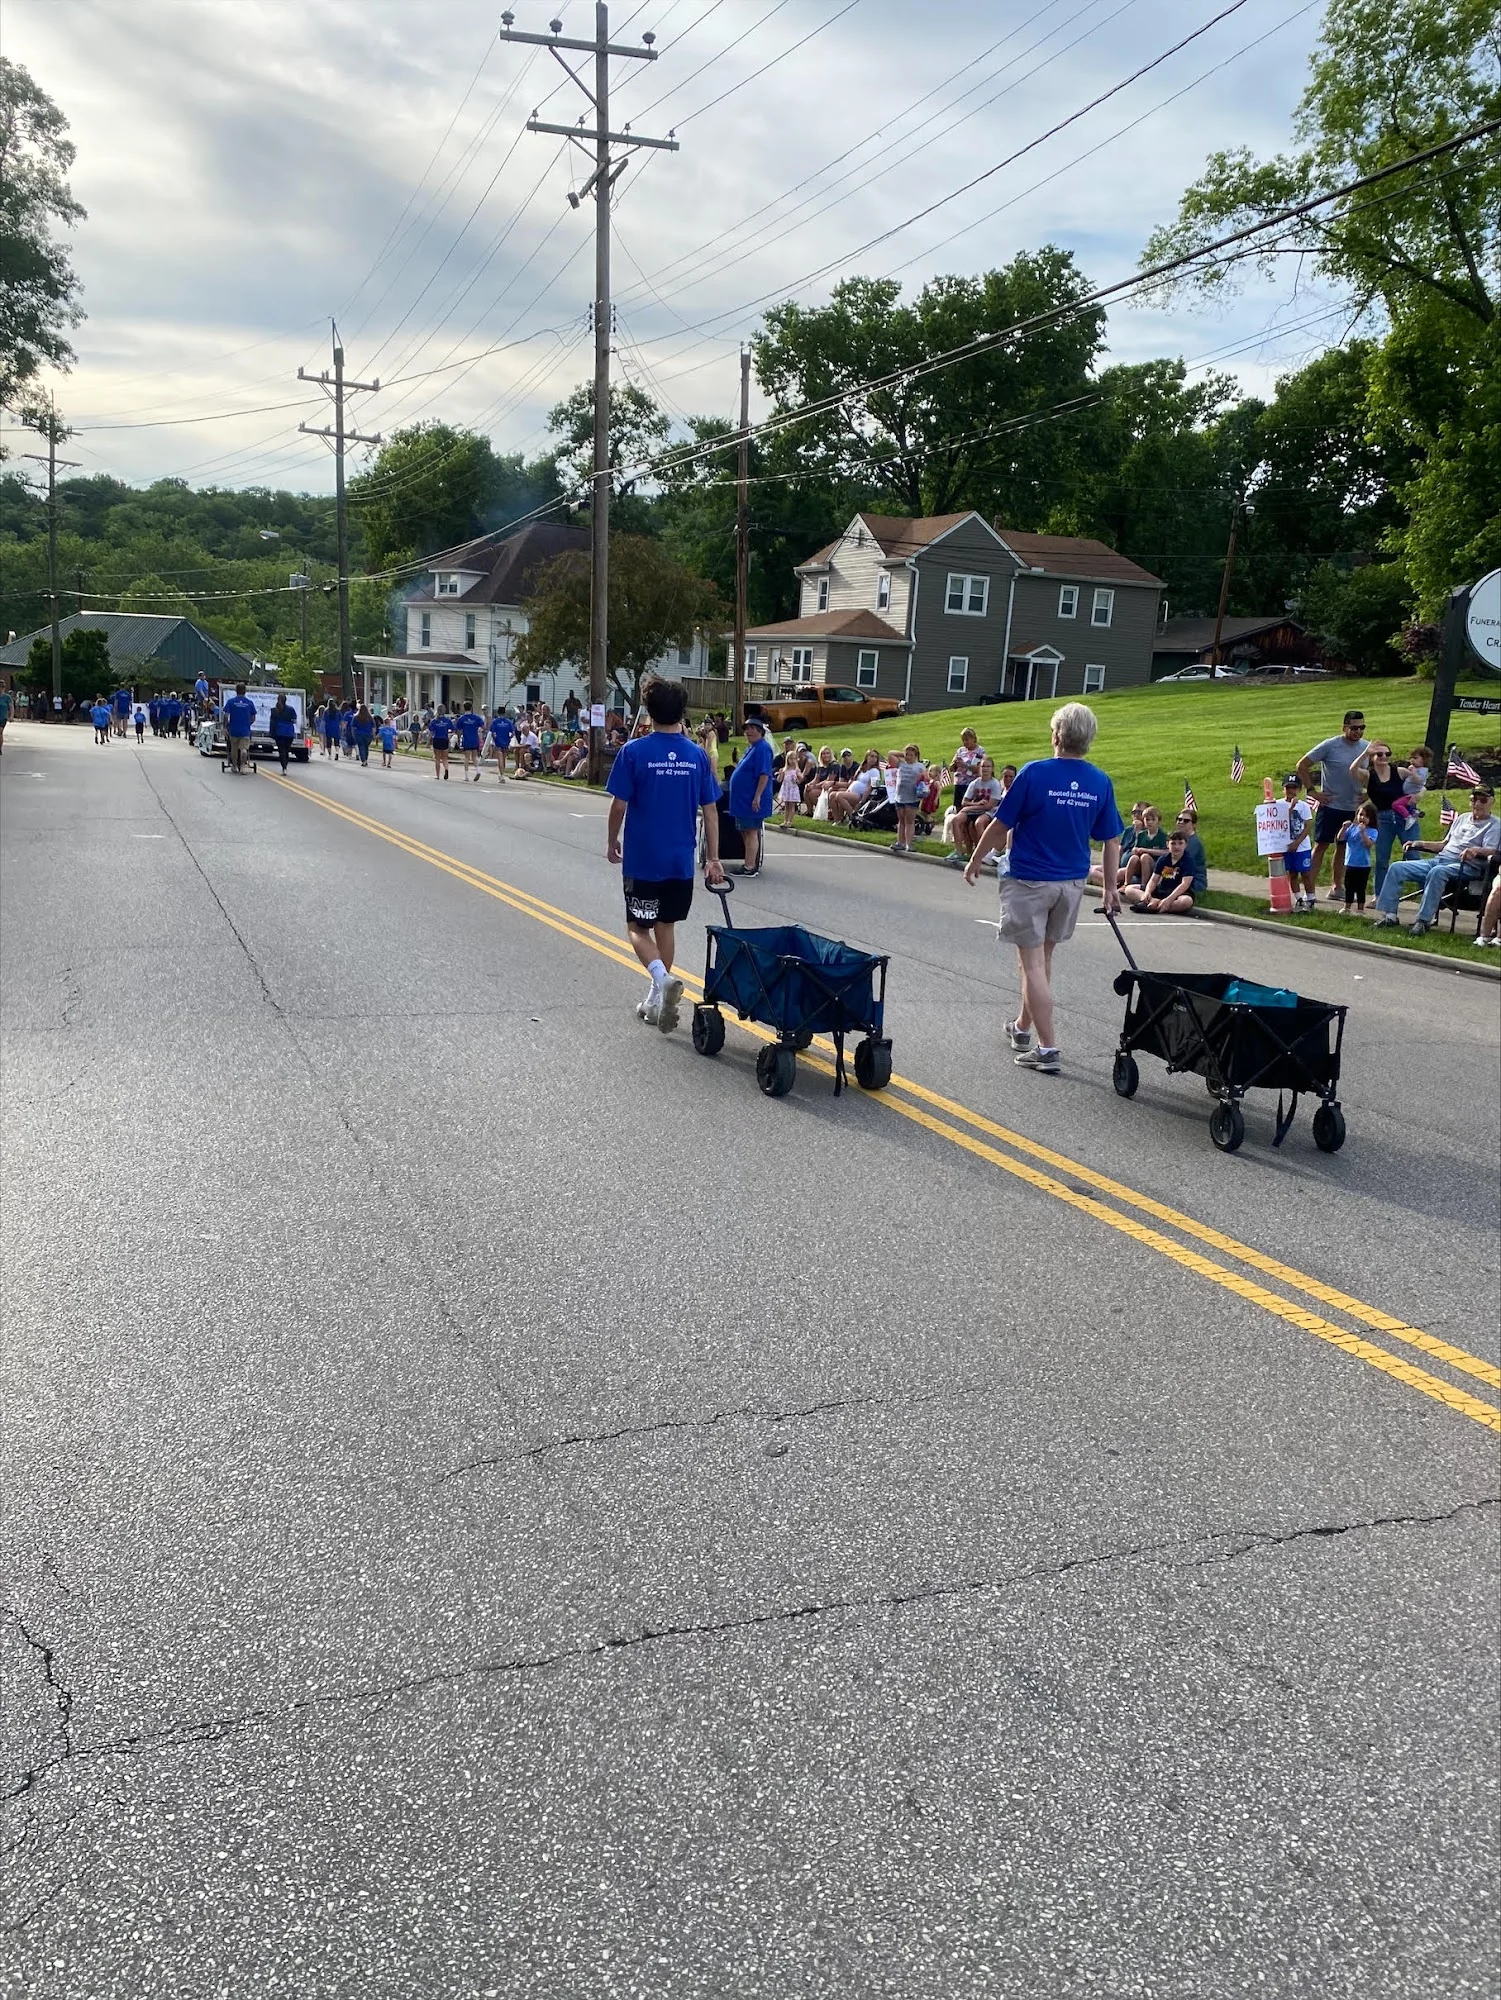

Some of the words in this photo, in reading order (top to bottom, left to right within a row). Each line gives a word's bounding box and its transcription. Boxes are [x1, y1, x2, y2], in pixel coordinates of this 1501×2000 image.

[1486, 637, 1501, 647] CR
[1460, 698, 1482, 709] Tender
[1266, 807, 1278, 817] NO
[1258, 820, 1288, 832] PARKING
